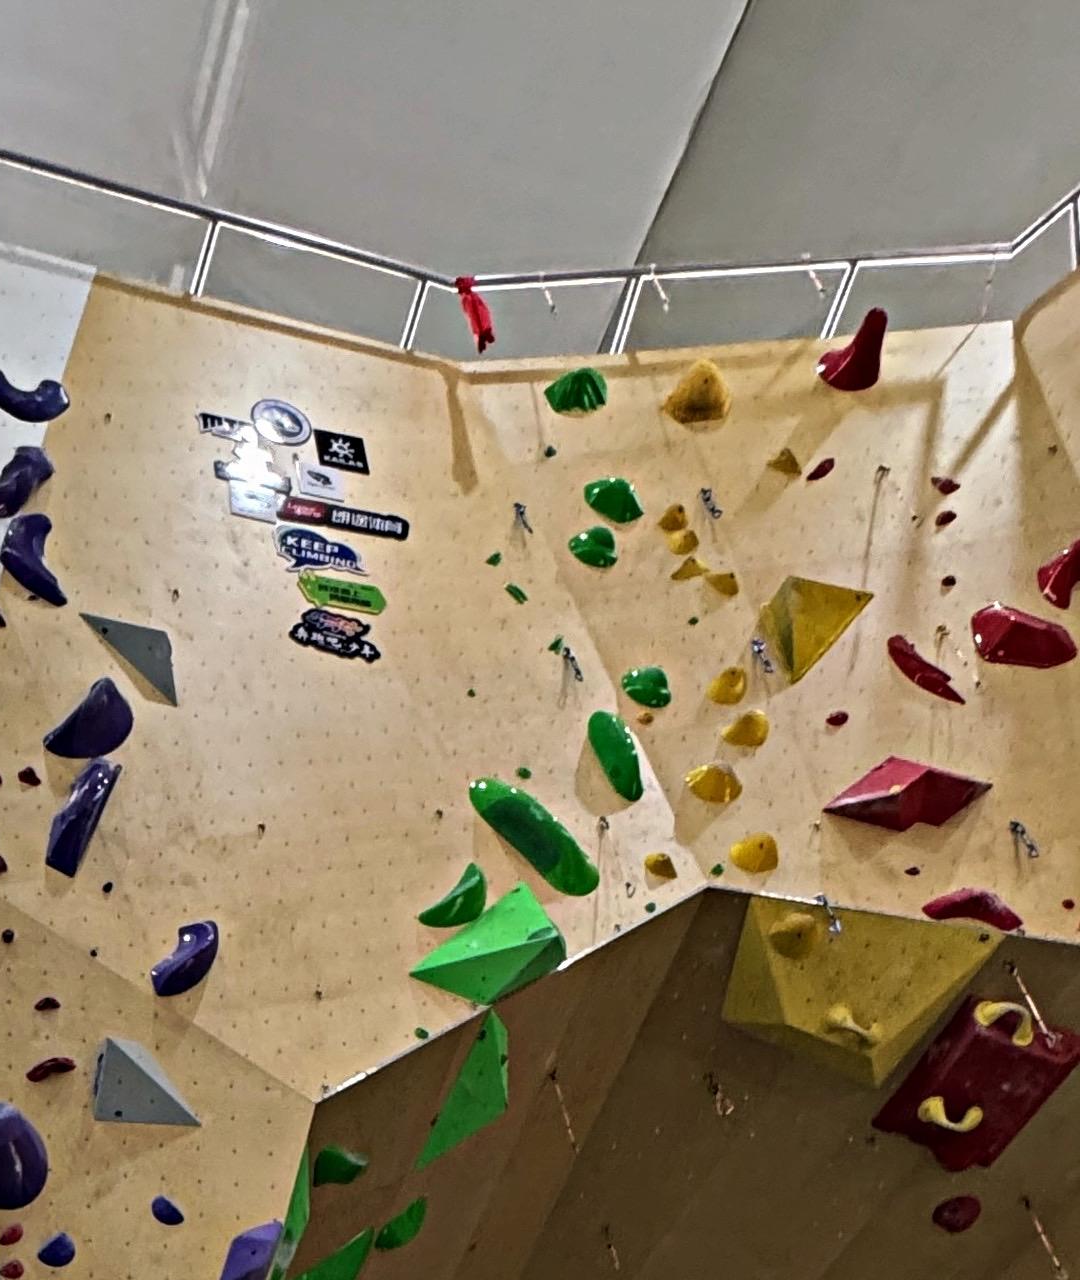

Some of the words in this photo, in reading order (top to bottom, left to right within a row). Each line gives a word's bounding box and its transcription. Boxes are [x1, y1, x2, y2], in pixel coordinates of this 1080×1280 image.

[323, 454, 364, 468] KAILAS
[286, 536, 339, 553] KEEP
[281, 546, 357, 569] CLIMBING
